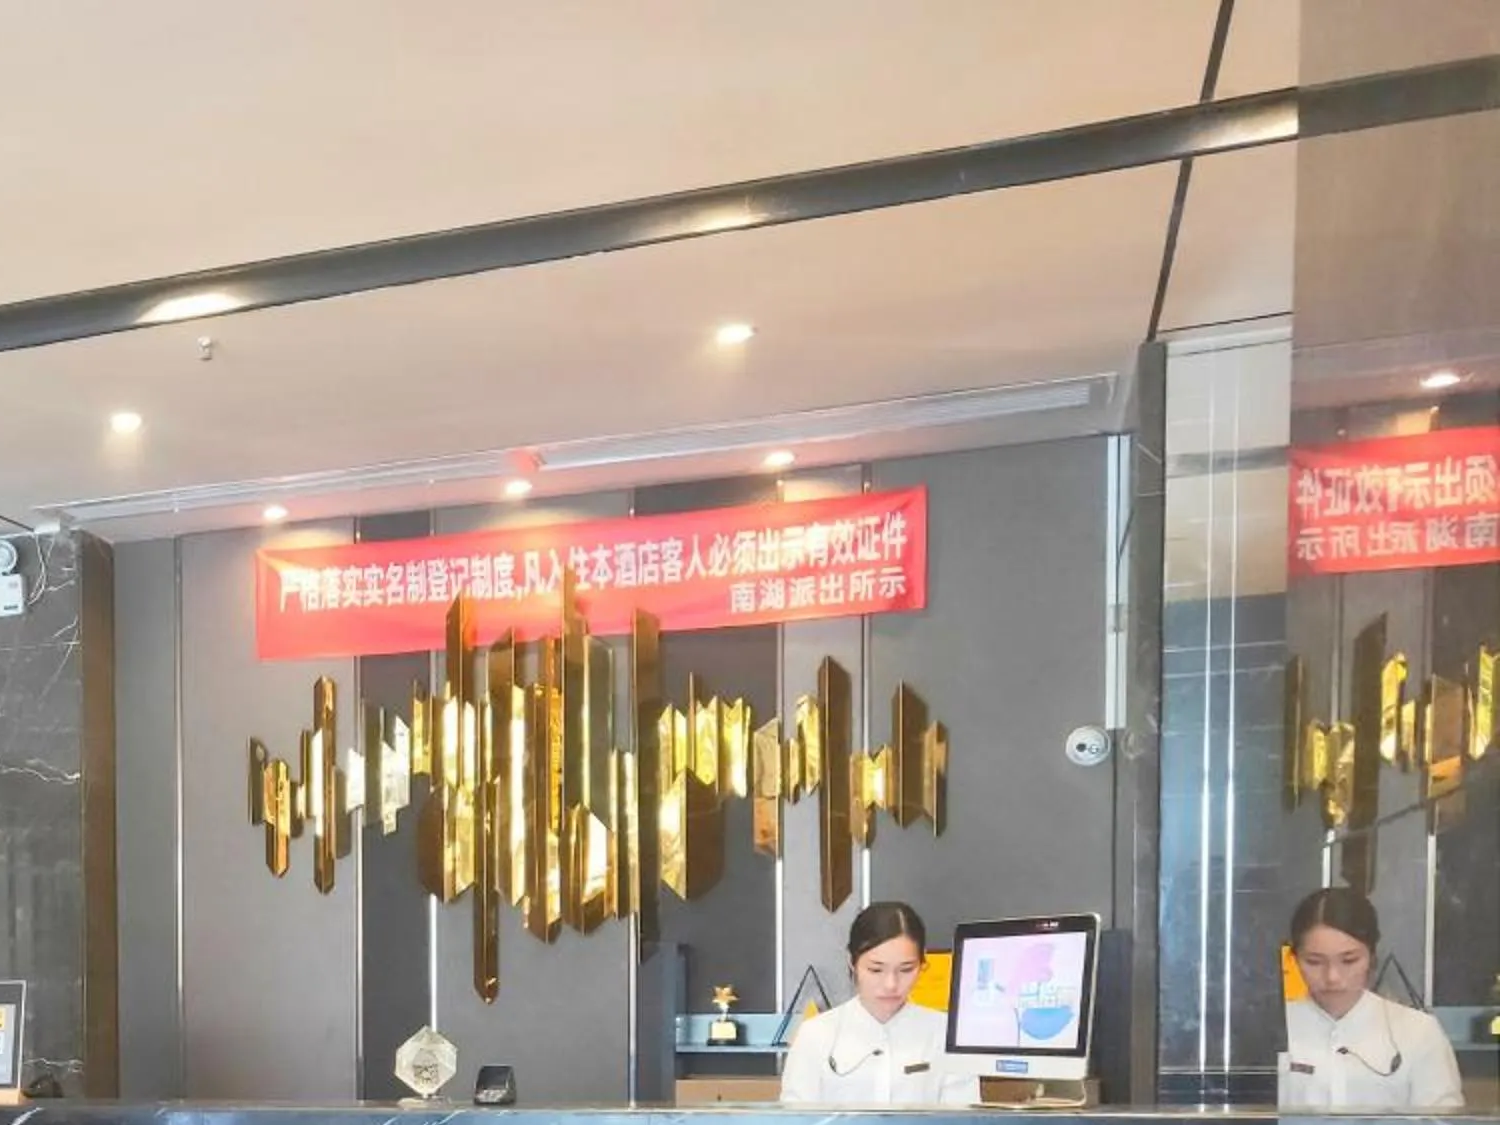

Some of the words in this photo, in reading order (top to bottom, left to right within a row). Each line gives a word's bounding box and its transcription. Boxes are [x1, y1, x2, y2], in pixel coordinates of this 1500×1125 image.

[729, 566, 907, 615] 南湖派出所示
